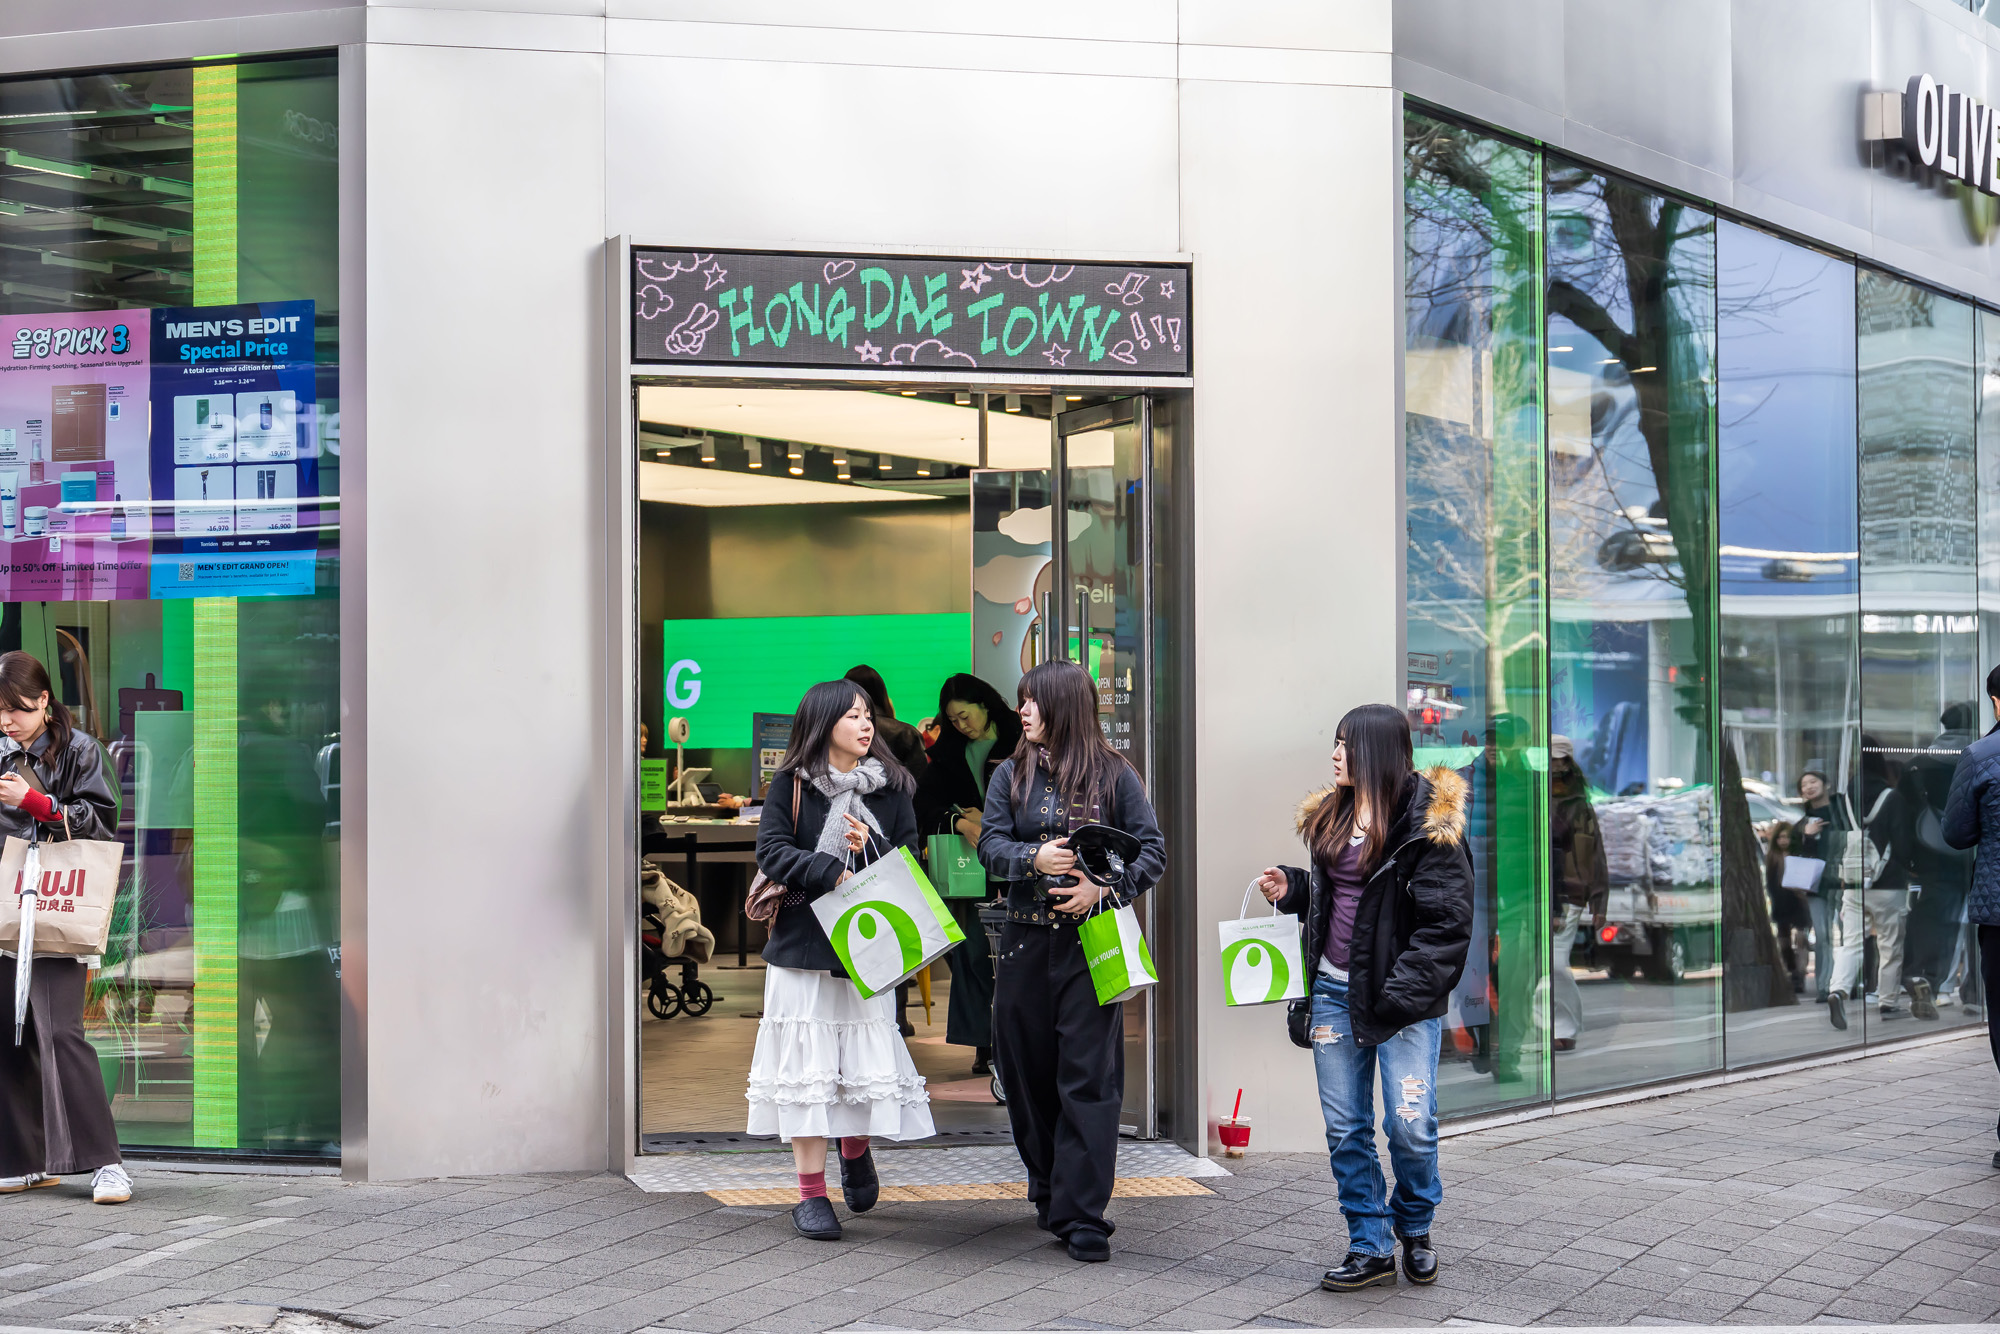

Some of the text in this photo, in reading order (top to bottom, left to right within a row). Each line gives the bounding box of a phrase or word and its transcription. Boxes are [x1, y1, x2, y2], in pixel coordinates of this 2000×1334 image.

[1907, 73, 2000, 196] OLIVE
[166, 316, 301, 339] MEN'S EDIT
[968, 293, 1122, 362] TOWN
[111, 324, 130, 354] 3
[180, 338, 288, 364] Special Price
[238, 364, 261, 372] edition
[11, 564, 21, 572] to
[23, 563, 40, 572] 50%
[42, 562, 56, 572] Off
[61, 562, 94, 571] Limited
[97, 561, 118, 570] Time
[120, 561, 142, 570] Offer
[666, 659, 702, 709] G
[1097, 677, 1111, 689] OPEN
[1115, 693, 1130, 705] 22:30
[681, 724, 687, 737] 3
[1100, 721, 1130, 733] PEN 10:00
[1115, 738, 1131, 750] 23:00
[850, 885, 860, 893] LIVE
[860, 874, 877, 886] BETTER
[18, 898, 75, 913] 印良品
[1099, 946, 1120, 962] YOUNG
